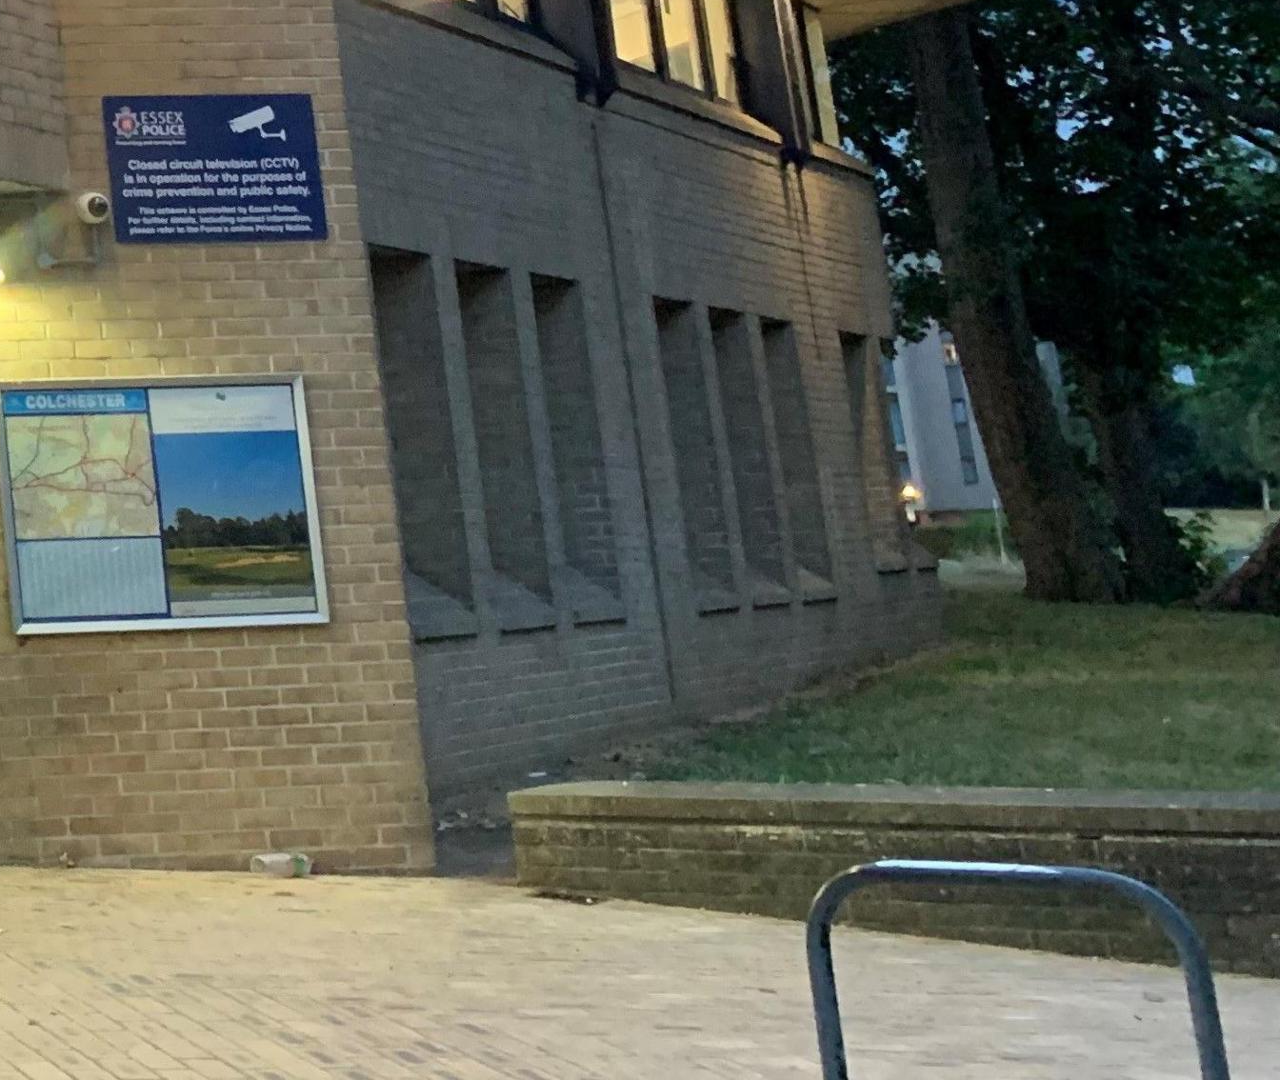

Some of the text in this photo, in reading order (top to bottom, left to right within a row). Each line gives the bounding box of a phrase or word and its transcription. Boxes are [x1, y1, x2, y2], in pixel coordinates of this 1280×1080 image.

[141, 111, 184, 124] ESSEX
[142, 124, 186, 136] POLICE
[128, 157, 299, 170] Closed circuit television (CCTV)
[136, 173, 147, 183] in
[149, 173, 201, 185] operation
[203, 172, 219, 183] for
[221, 172, 239, 182] the
[242, 173, 293, 185] purposes
[295, 171, 306, 181] of
[122, 187, 153, 197] crime
[155, 186, 214, 199] prevention
[217, 186, 237, 196] and
[240, 185, 273, 198] public
[25, 393, 125, 409] COLCHESTER
